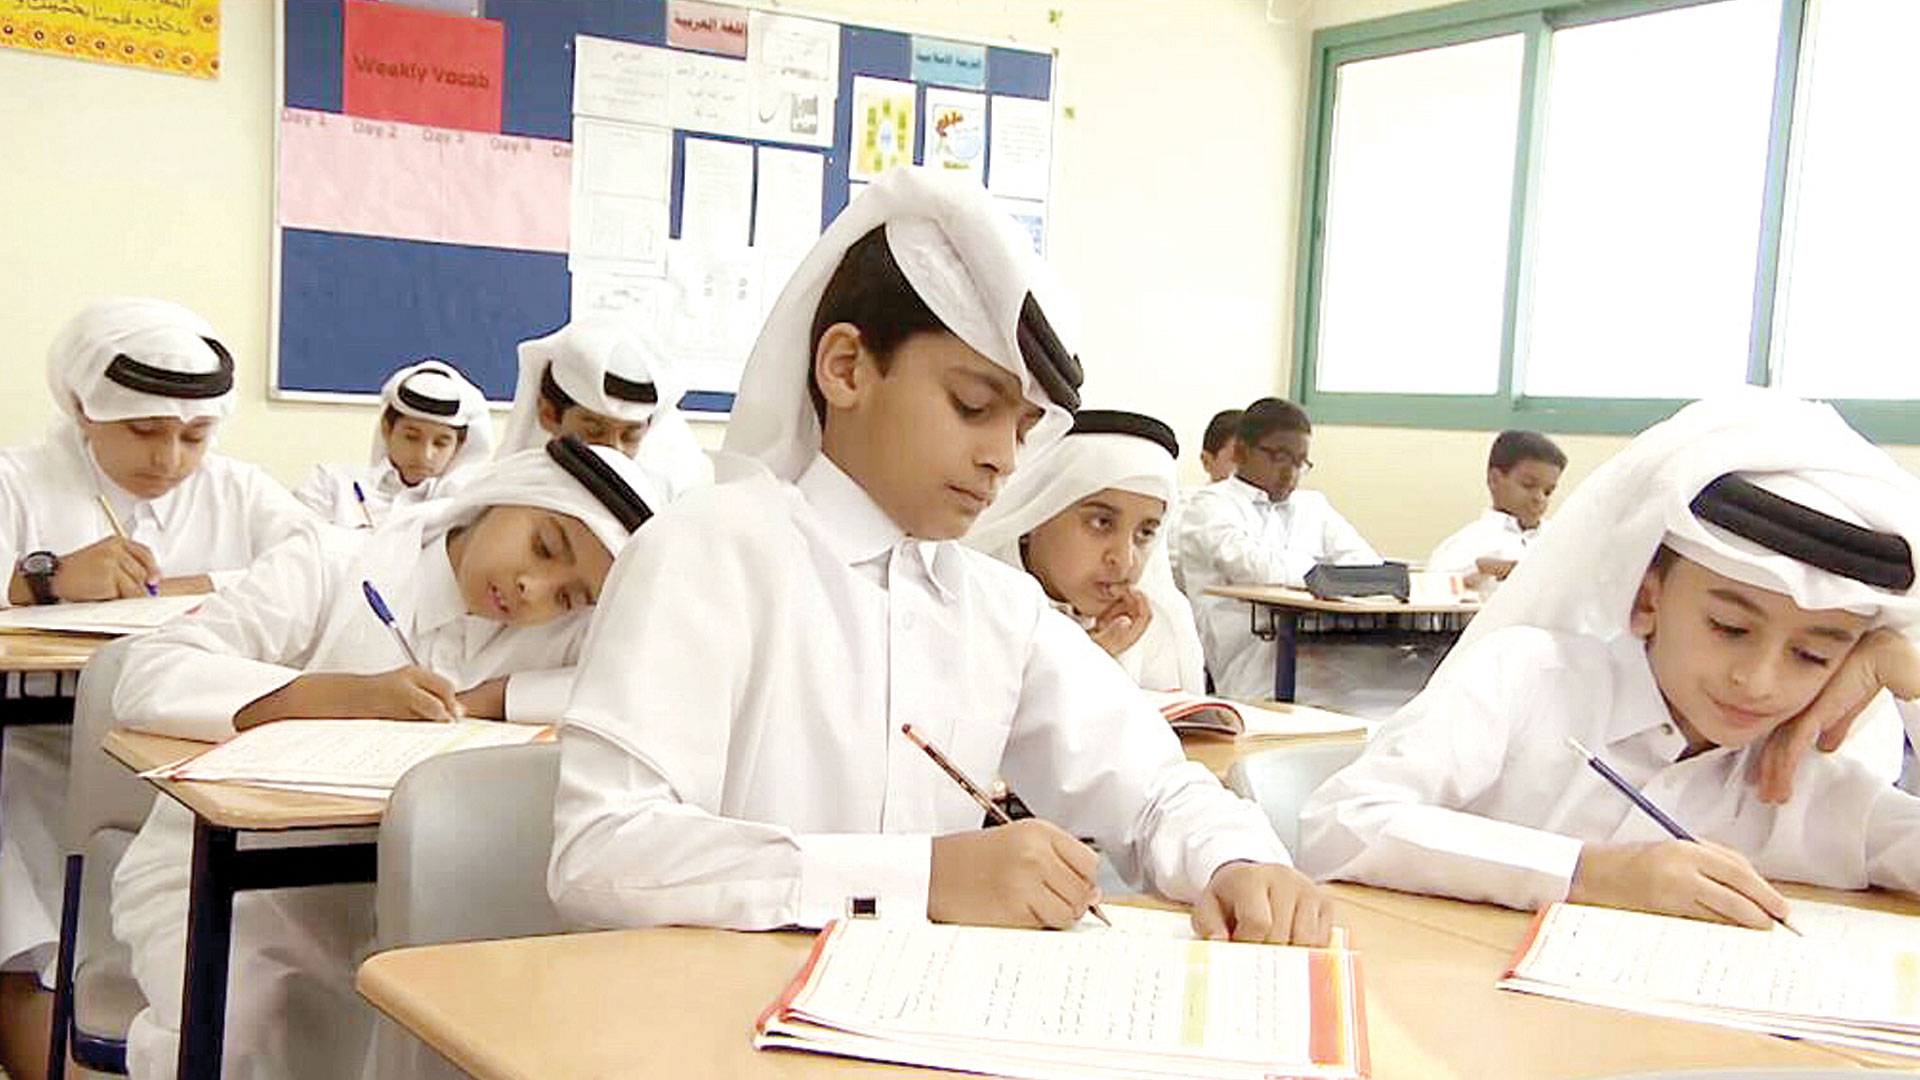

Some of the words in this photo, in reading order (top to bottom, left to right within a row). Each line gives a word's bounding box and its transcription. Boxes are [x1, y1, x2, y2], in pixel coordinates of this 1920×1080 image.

[673, 10, 718, 33] العربية
[353, 52, 427, 84] Weekly
[434, 65, 490, 90] Vocab
[281, 109, 311, 125] Day
[352, 119, 385, 138] Day
[387, 125, 398, 138] 2
[422, 127, 450, 145] Day
[490, 137, 518, 154] Day
[552, 144, 572, 158] Da
